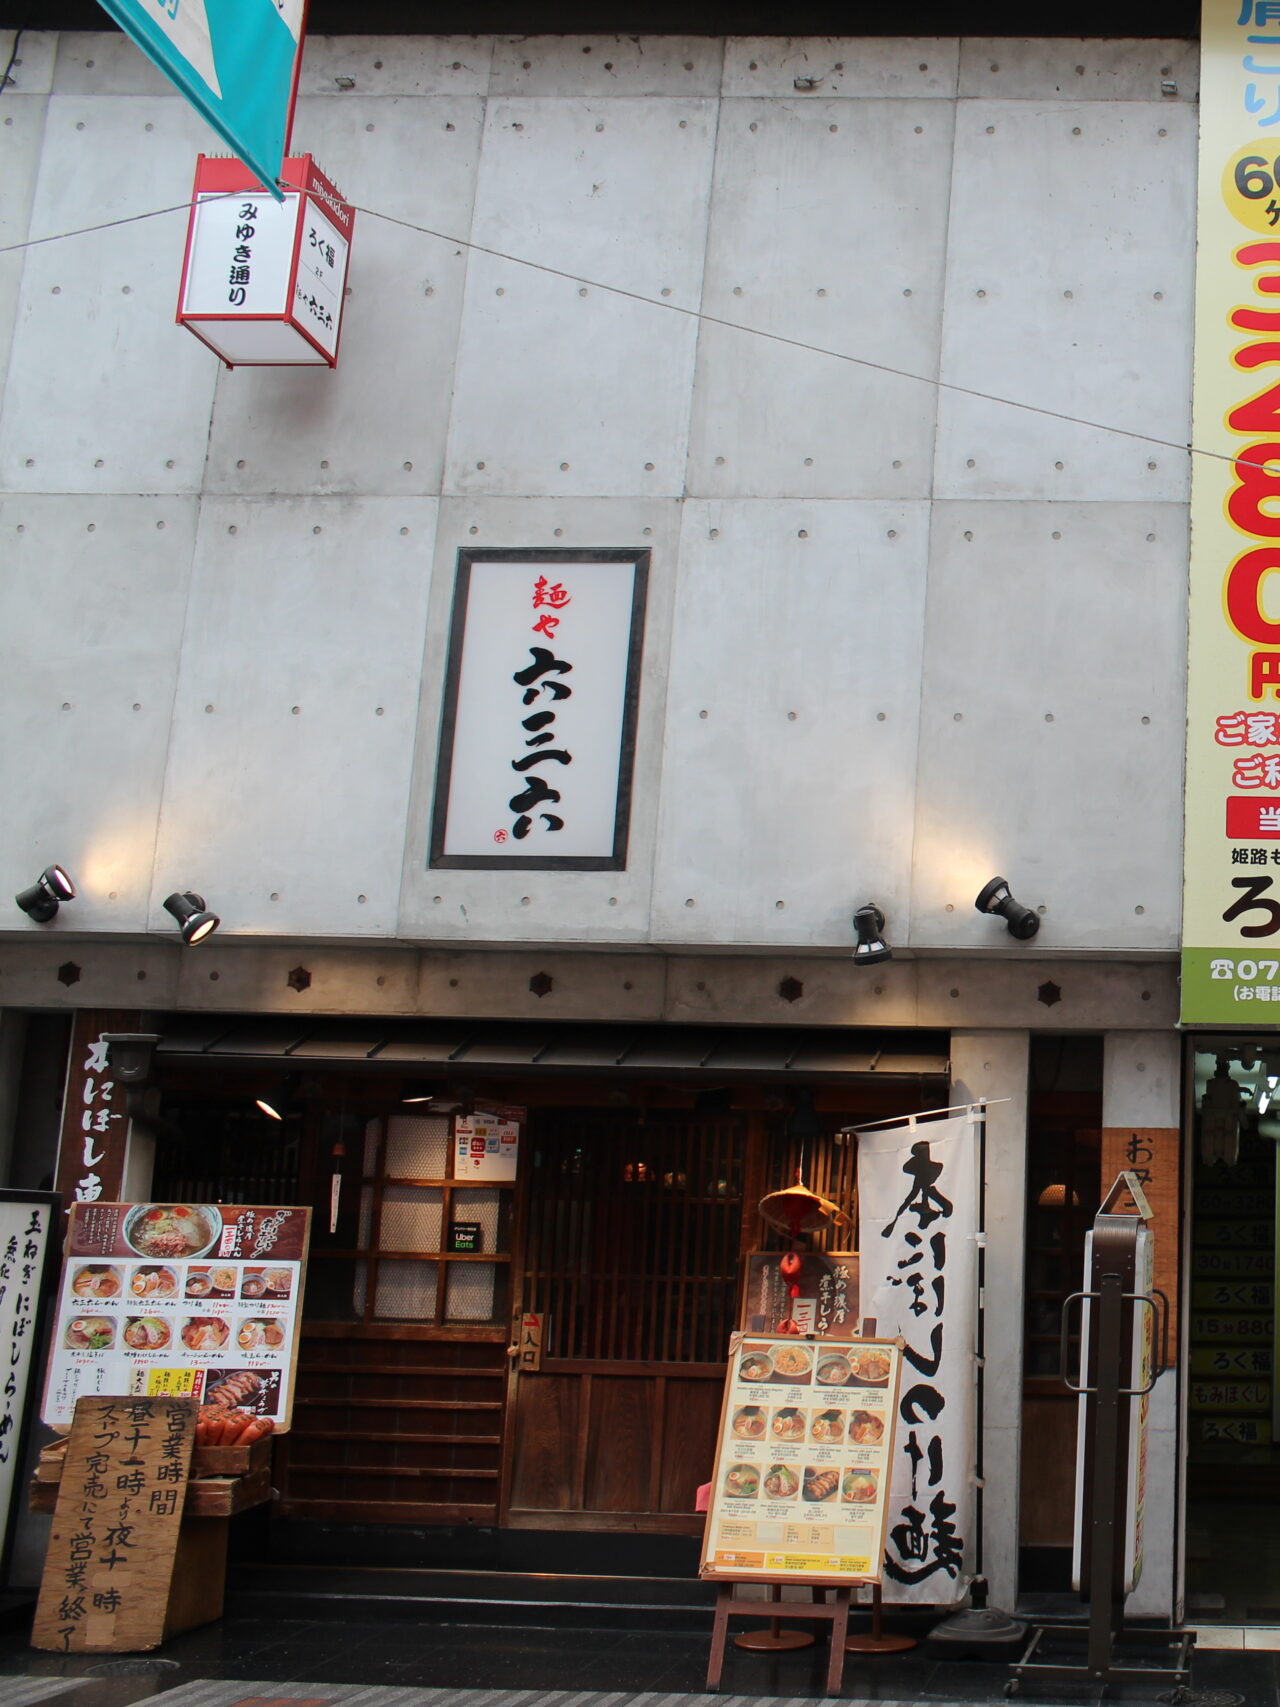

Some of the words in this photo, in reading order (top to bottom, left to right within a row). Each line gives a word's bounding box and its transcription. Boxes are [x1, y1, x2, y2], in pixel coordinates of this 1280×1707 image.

[229, 202, 258, 307] みゆき通り
[309, 228, 335, 269] ろく福
[455, 1232, 474, 1241] Uber
[455, 1240, 474, 1249] Eats
[1214, 1286, 1271, 1306] ろく福
[523, 1331, 539, 1364] 入口
[1213, 1351, 1271, 1372] ろく福
[1204, 1421, 1258, 1441] ろく福
[150, 1401, 195, 1516] 営業時間
